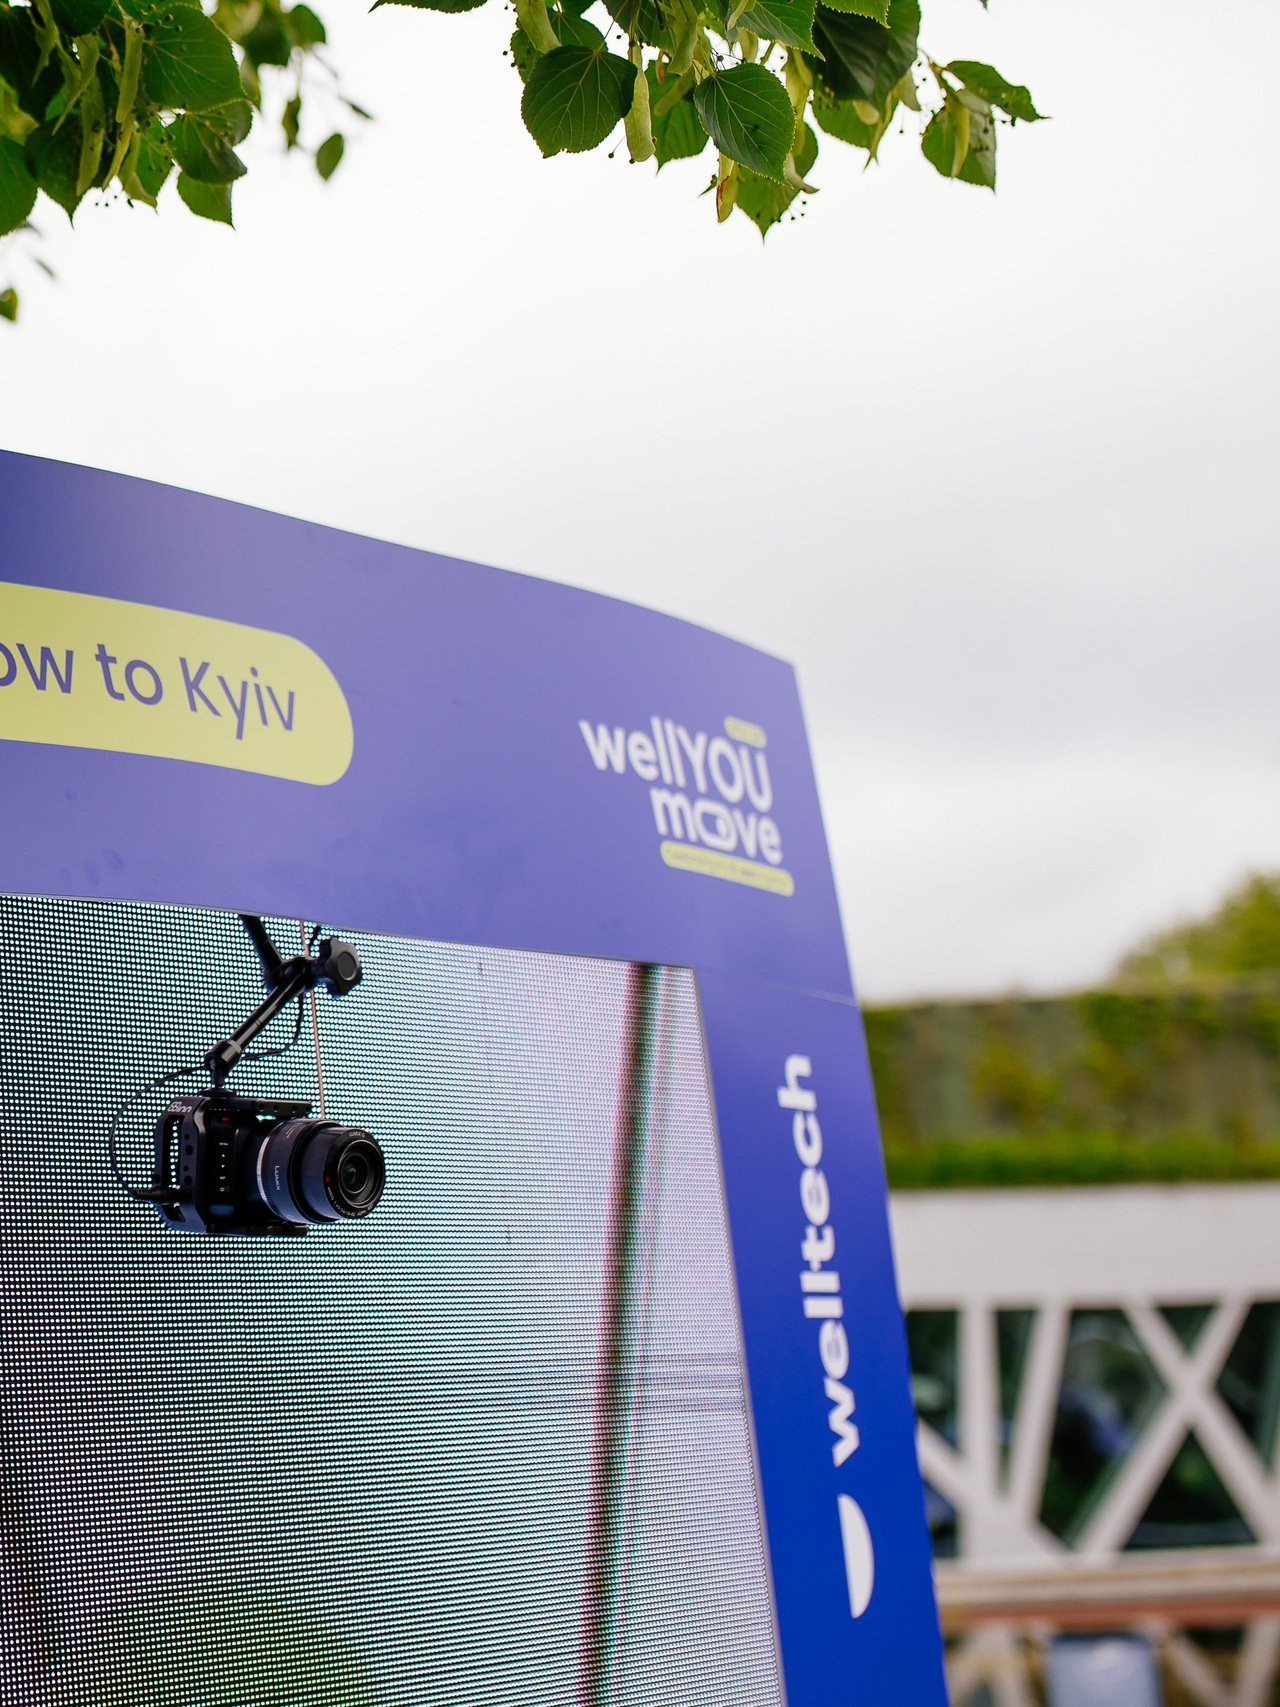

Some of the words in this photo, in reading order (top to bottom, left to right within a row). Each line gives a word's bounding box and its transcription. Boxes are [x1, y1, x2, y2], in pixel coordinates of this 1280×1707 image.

[94, 643, 164, 706] to
[179, 655, 296, 740] Kyiv
[577, 715, 773, 813] wellYOU
[649, 786, 784, 866] move
[777, 1053, 862, 1468] welltech
